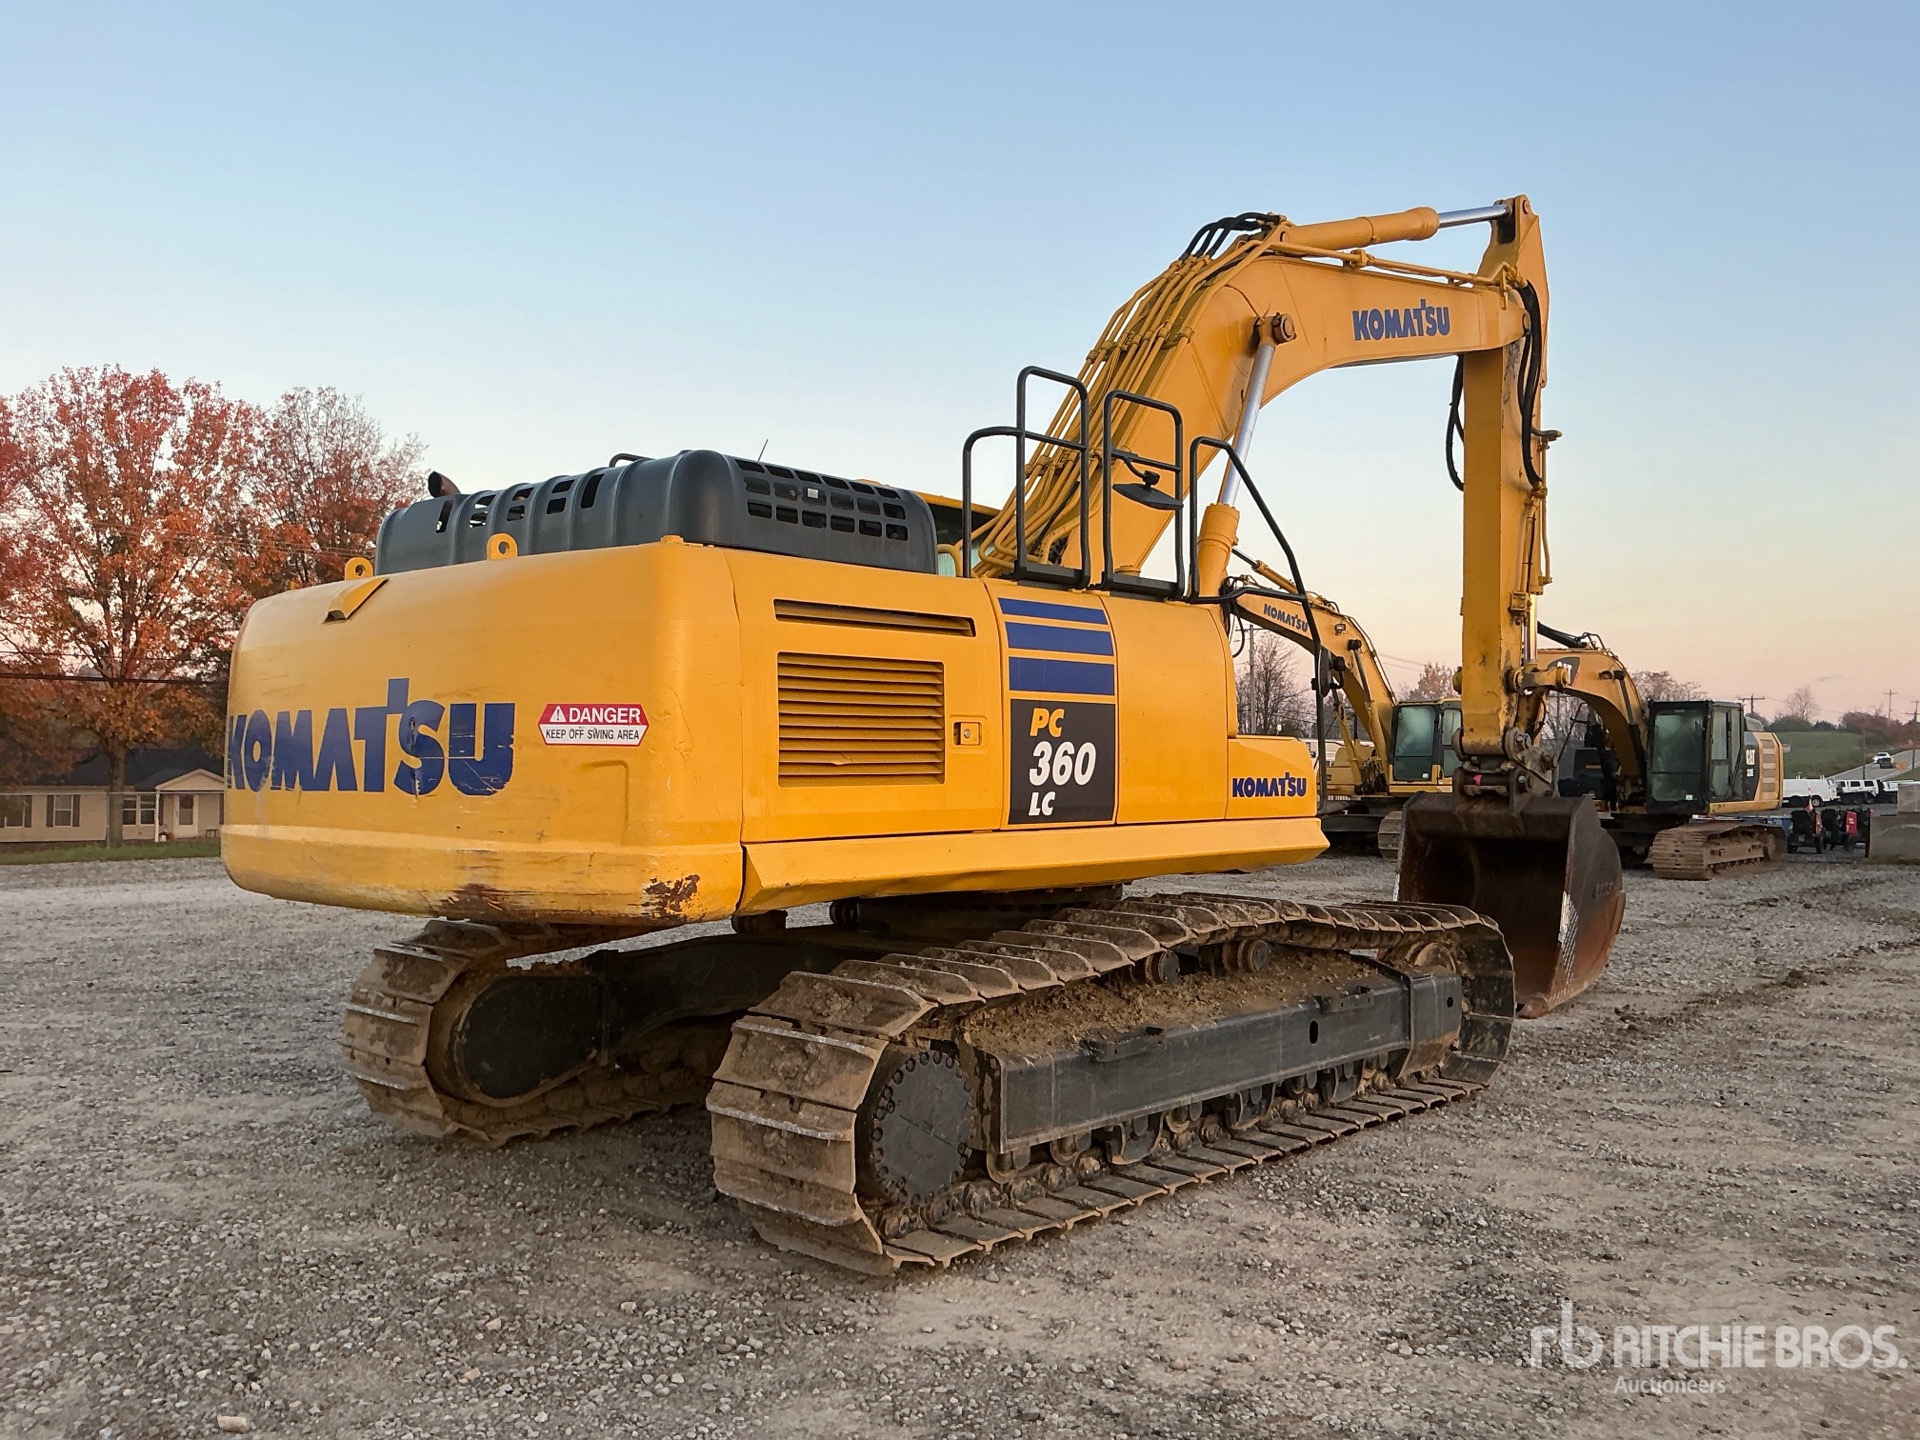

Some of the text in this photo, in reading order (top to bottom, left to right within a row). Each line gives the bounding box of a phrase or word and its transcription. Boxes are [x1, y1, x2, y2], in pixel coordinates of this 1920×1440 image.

[1352, 298, 1450, 341] KOMATSU
[1263, 603, 1309, 633] KOMATSU
[569, 707, 641, 724] DANGER
[1029, 707, 1065, 738] PC
[227, 678, 515, 796] KOMATSU
[545, 728, 640, 740] KEEP OFF SWING AREA
[1029, 740, 1097, 787] 360
[1232, 772, 1307, 798] KOMATSU
[1028, 791, 1056, 816] LC
